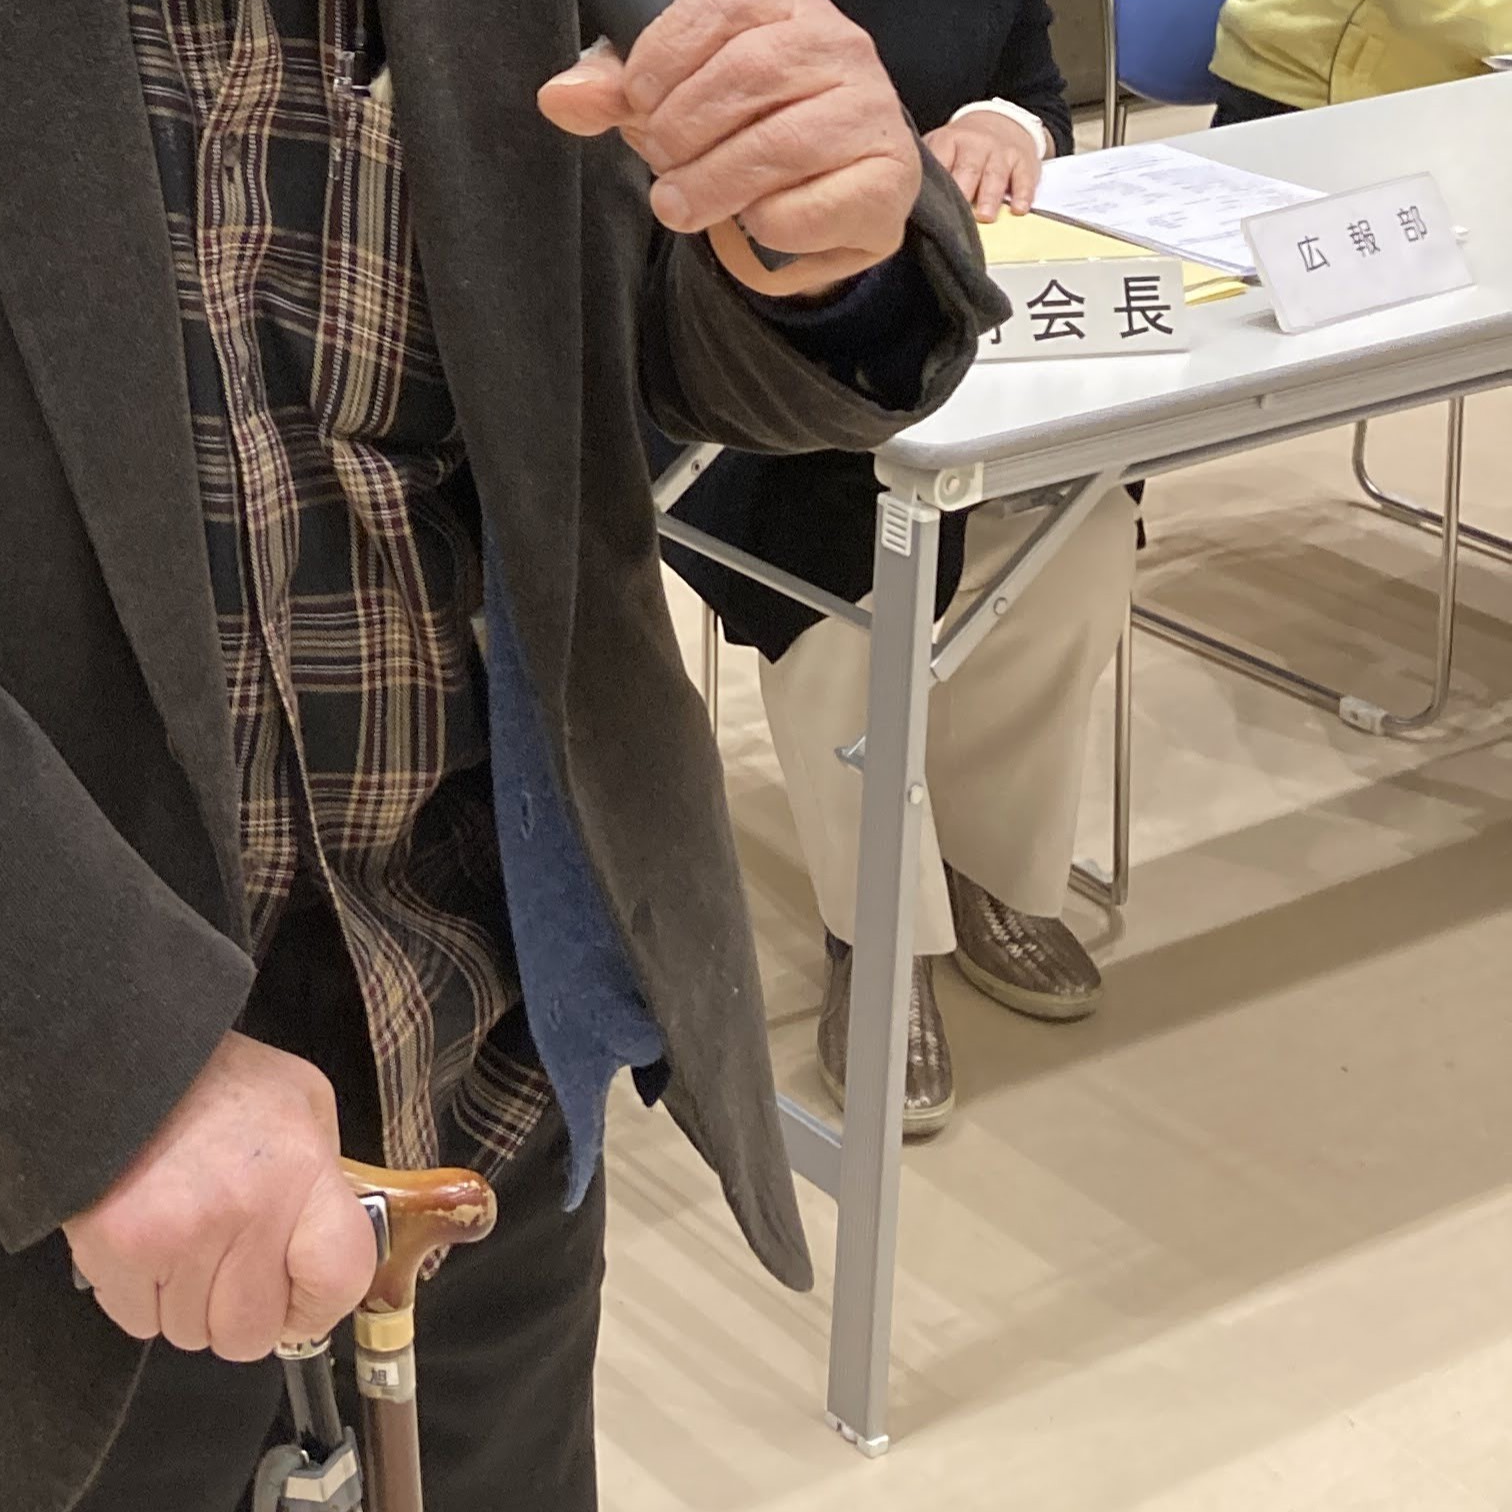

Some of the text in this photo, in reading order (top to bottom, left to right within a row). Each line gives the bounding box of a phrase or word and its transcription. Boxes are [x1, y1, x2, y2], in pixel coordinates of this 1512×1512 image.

[1297, 205, 1428, 272] 広報部
[990, 276, 1174, 345] 会長
